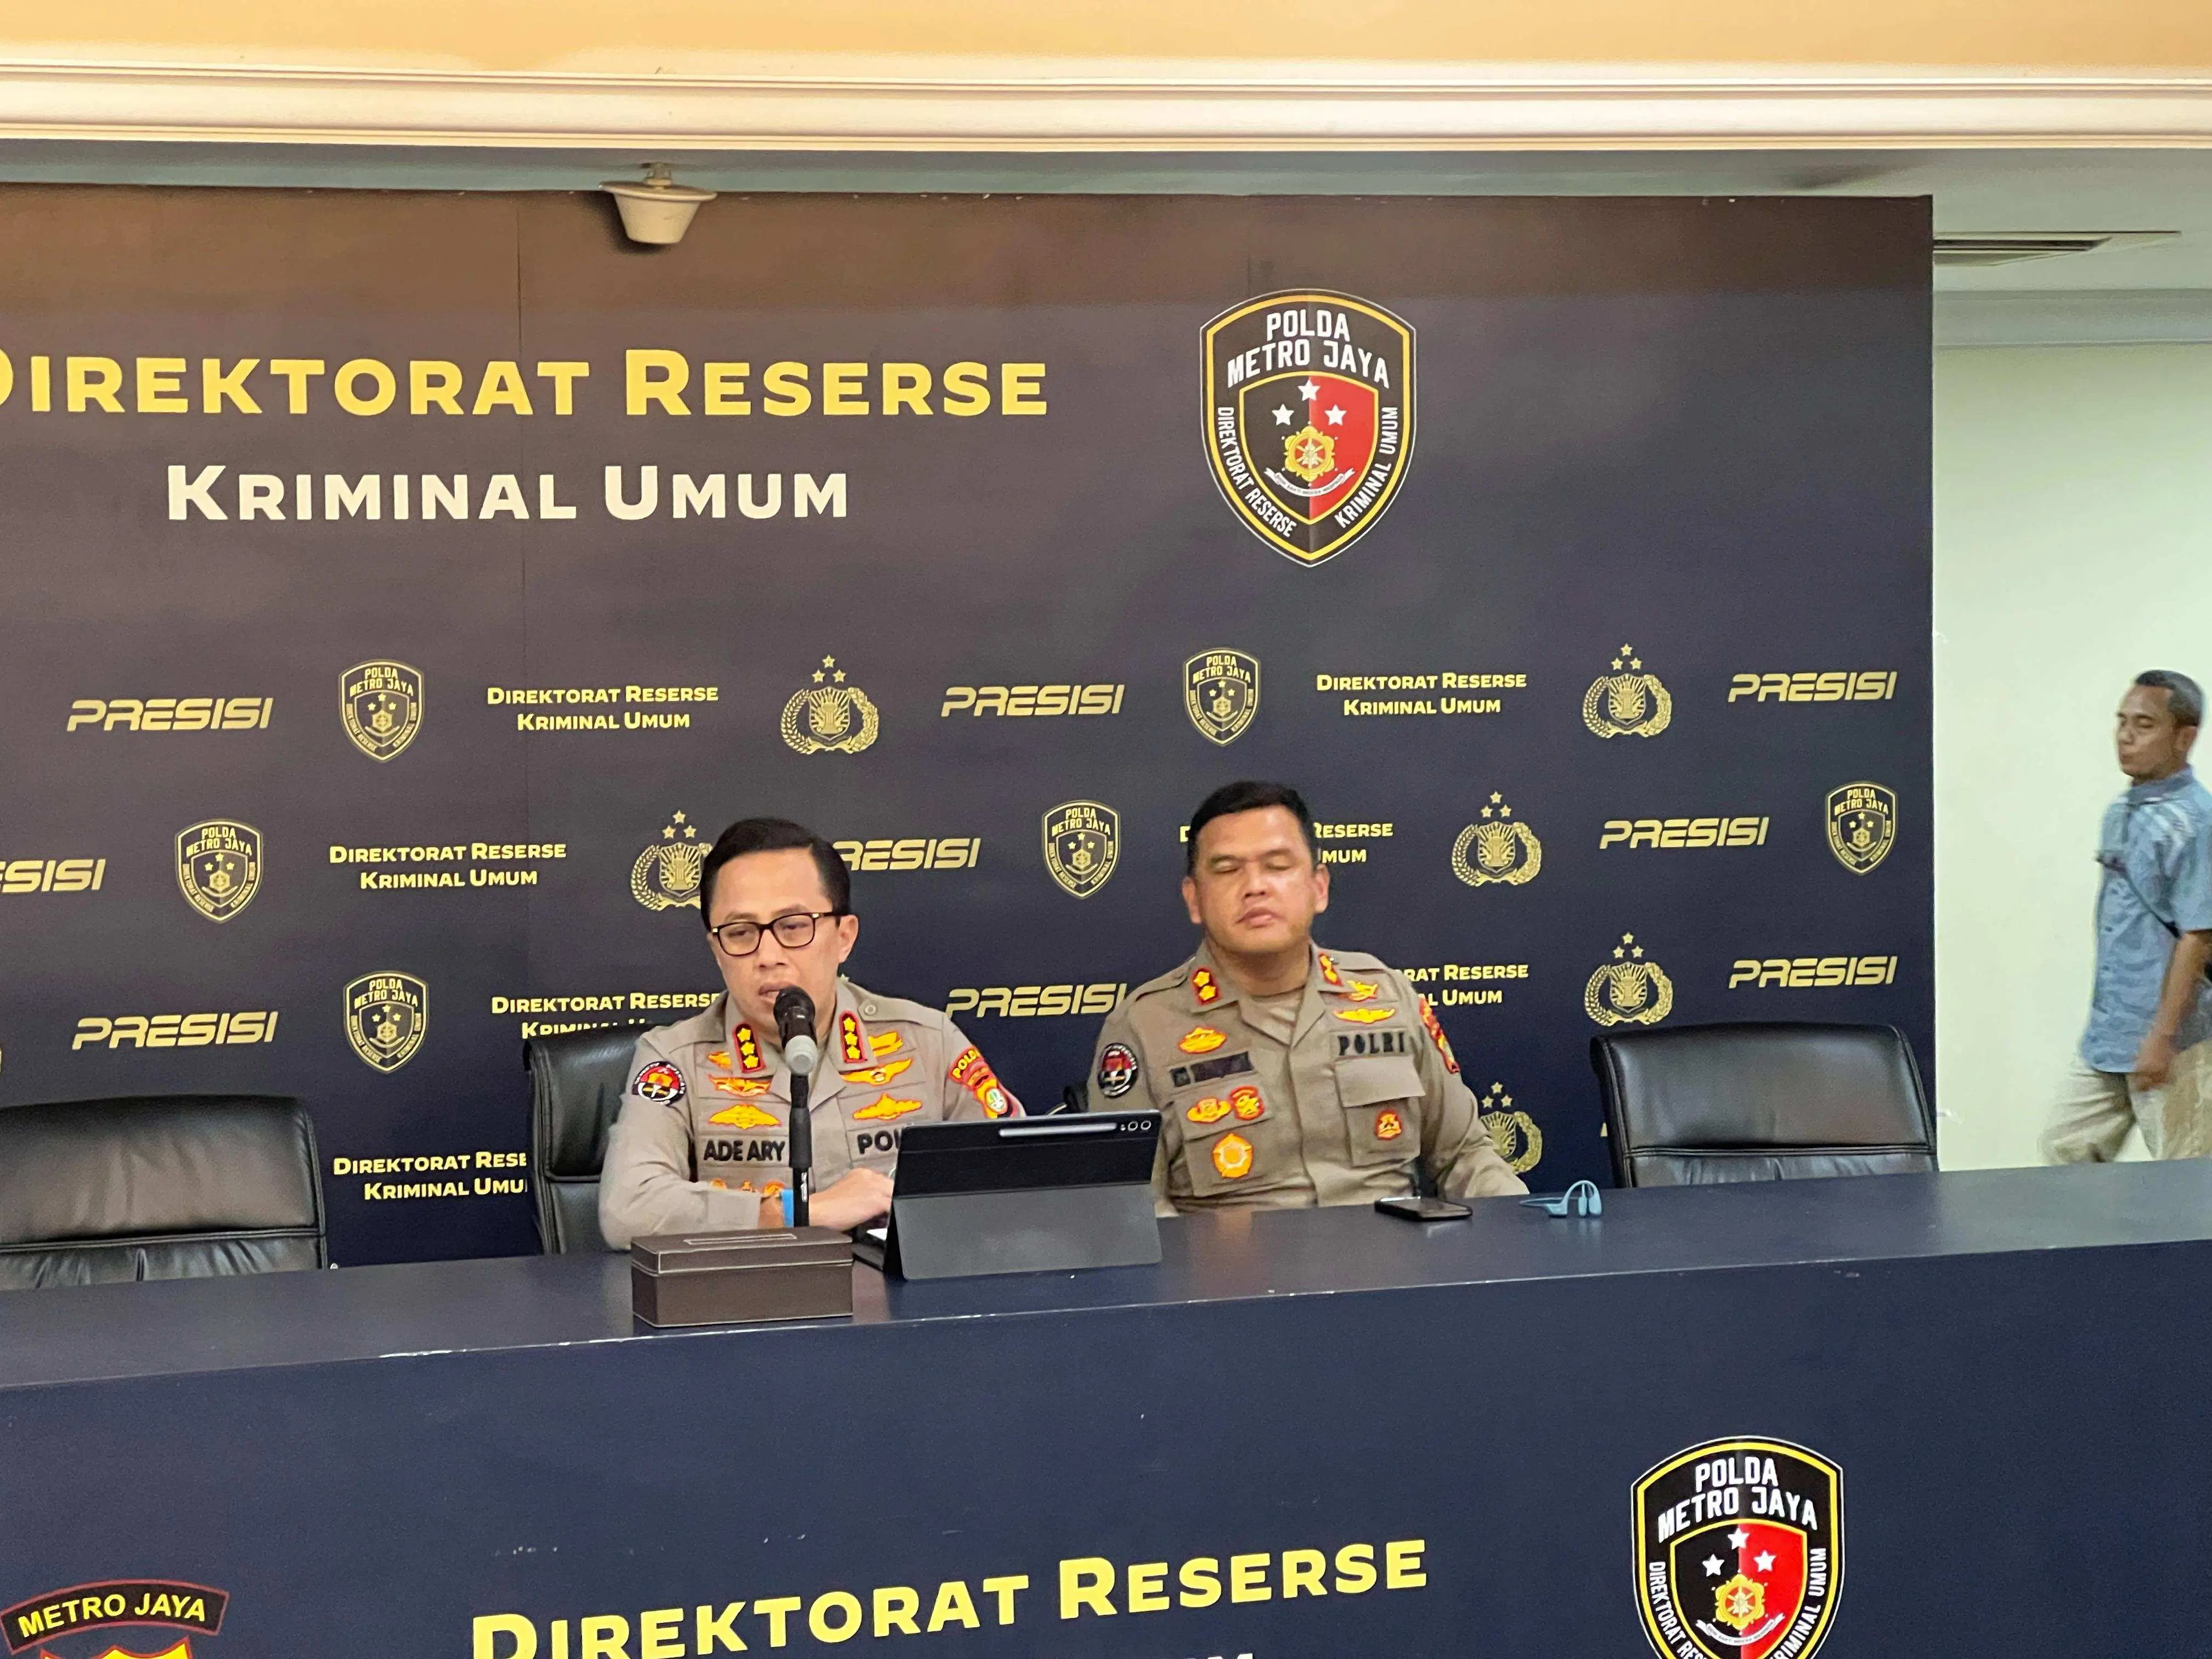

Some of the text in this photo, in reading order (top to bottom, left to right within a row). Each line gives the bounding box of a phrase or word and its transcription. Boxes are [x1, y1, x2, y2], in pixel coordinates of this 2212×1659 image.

[1266, 309, 1350, 341] POLDA
[1227, 339, 1389, 388] METRO JAYA
[0, 348, 1047, 416] IREKTORAT RESERSE
[1217, 407, 1296, 537] DIREKTORAT RESERSE
[1334, 406, 1398, 528] KRIMINAL UMUM
[167, 465, 847, 521] KRIMINAL UMUM
[1206, 655, 1237, 667] POLDA
[364, 667, 398, 679] POLDA
[1227, 665, 1251, 683] JAYA
[1317, 672, 1527, 691] DIREKTORAT RESERSE
[387, 678, 414, 696] JAYA
[487, 685, 719, 704] DIREKTORAT RESERSE
[1728, 671, 1898, 703] PRESISI
[941, 684, 1125, 717] PRESISI
[1344, 697, 1500, 715] KRIMINAL UMUM
[66, 697, 274, 731] PRESISI
[517, 712, 690, 731] KRIMINAL UMUM
[1847, 788, 1876, 799] POLDA
[1065, 807, 1096, 820] POLDA
[1866, 798, 1889, 815] JAYA
[201, 826, 236, 839] POLDA
[1086, 818, 1110, 836] JAYA
[1599, 817, 1769, 849] PRESISI
[224, 838, 252, 856] JAYA
[330, 843, 567, 863] DIREKTORAT RESERSE
[832, 838, 981, 871] RESISI
[1318, 848, 1367, 864] MUM
[0, 858, 106, 893] SISI
[360, 869, 538, 889] KRIMINAL UMUM
[1444, 964, 1529, 981] RESERSE
[1729, 956, 1898, 989] PRESISI
[369, 978, 403, 991] POLDA
[391, 989, 418, 1007] JAYA
[492, 996, 625, 1014] DIREKTORAT
[1442, 989, 1503, 1006] UMUM
[72, 1011, 279, 1050] PRESISI
[1337, 1032, 1404, 1056] POLRI
[703, 1139, 786, 1161] ADE ARY
[333, 1151, 527, 1175] DIREKTORAT RESE
[364, 1177, 527, 1200] KRIMINAL UMU
[1695, 1457, 1779, 1492] POLDA
[1658, 1487, 1818, 1543] METRO JAYA
[473, 1539, 1426, 1659] DIREKTORAT RESERSE
[1649, 1562, 1686, 1645] DIREKTORAT
[1769, 1548, 1827, 1659] RIMINAL UMUM
[18, 1592, 206, 1638] METRO JAYA
